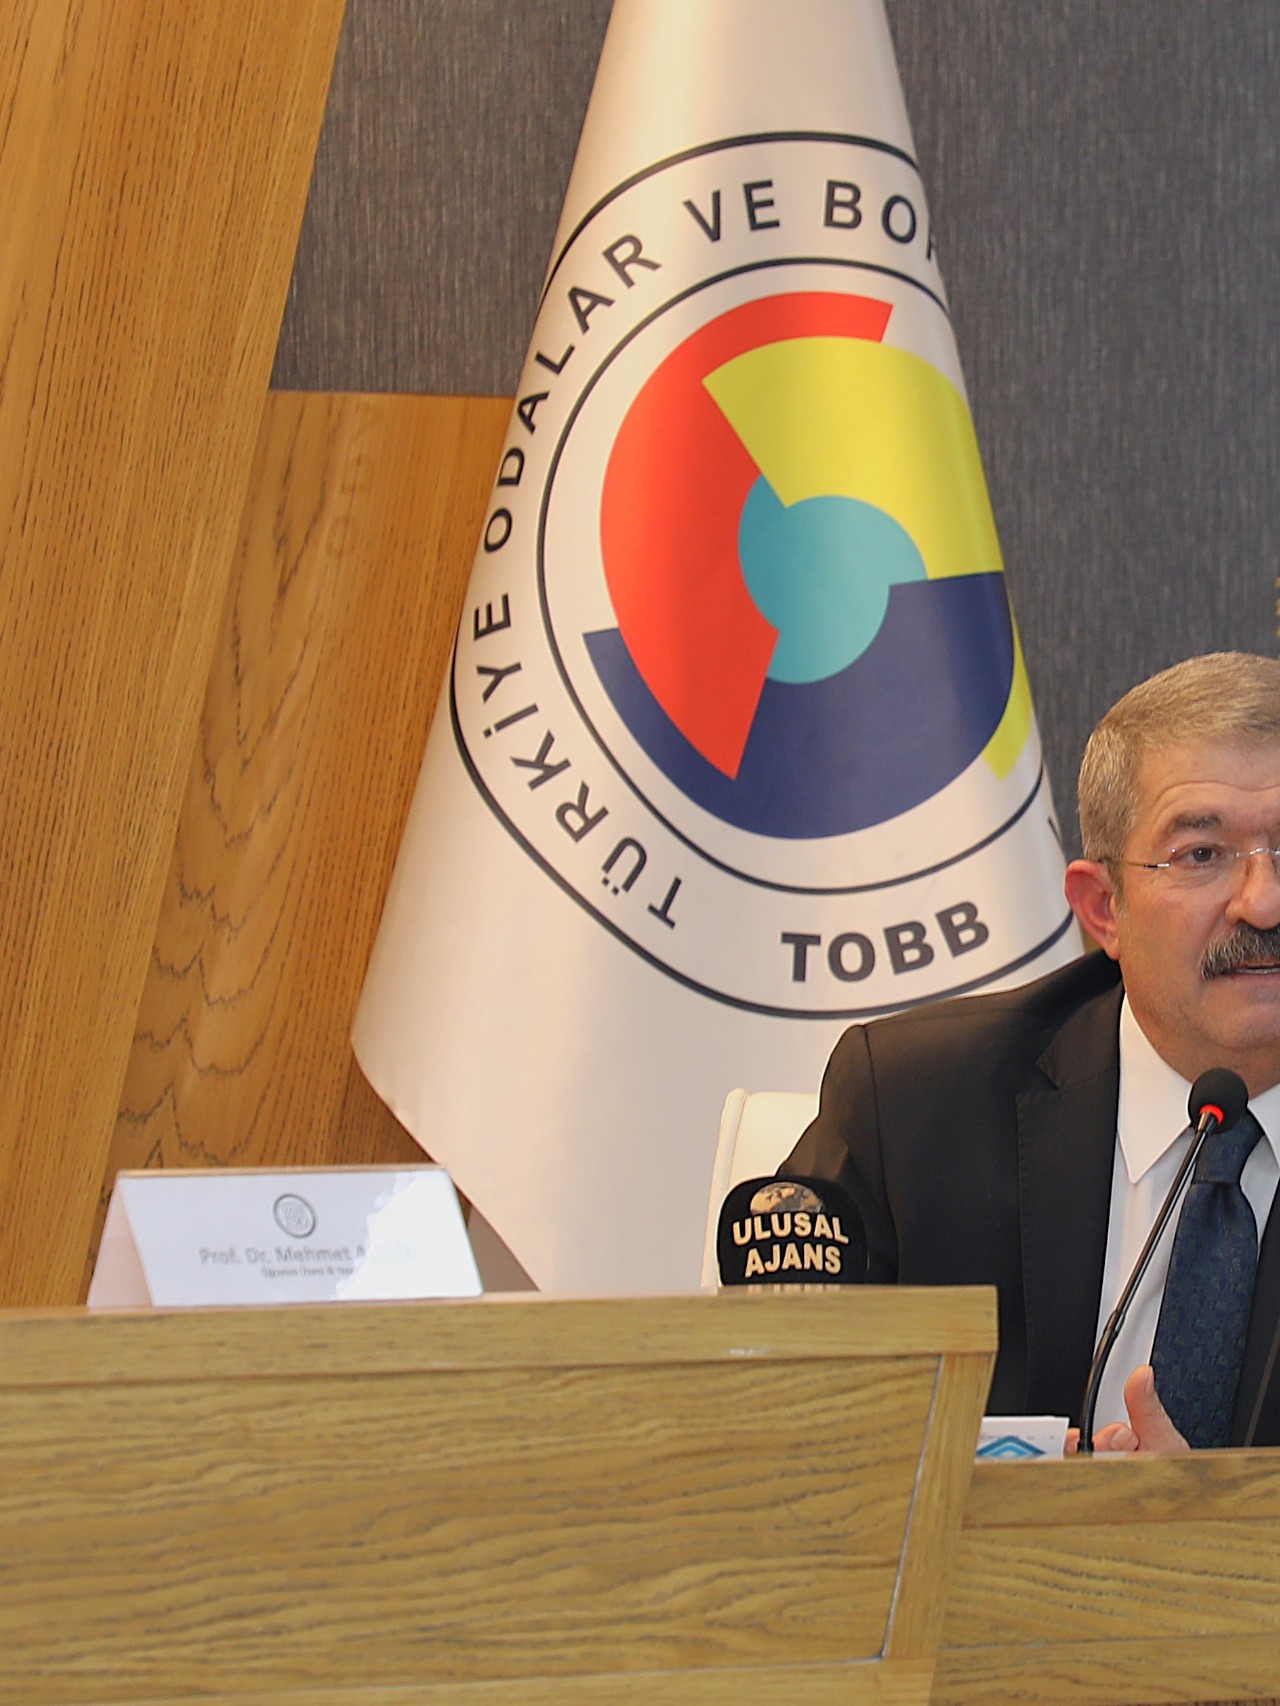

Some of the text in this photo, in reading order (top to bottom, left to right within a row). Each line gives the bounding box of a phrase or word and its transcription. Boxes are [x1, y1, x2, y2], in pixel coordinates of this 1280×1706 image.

[472, 178, 933, 930] TÜRKİYE ODALAR VE BO
[780, 900, 991, 983] TOBB
[732, 1212, 849, 1246] ULUSAL
[198, 1245, 240, 1265] Prof.
[274, 1244, 353, 1263] Mehmet
[744, 1243, 841, 1278] AJANS
